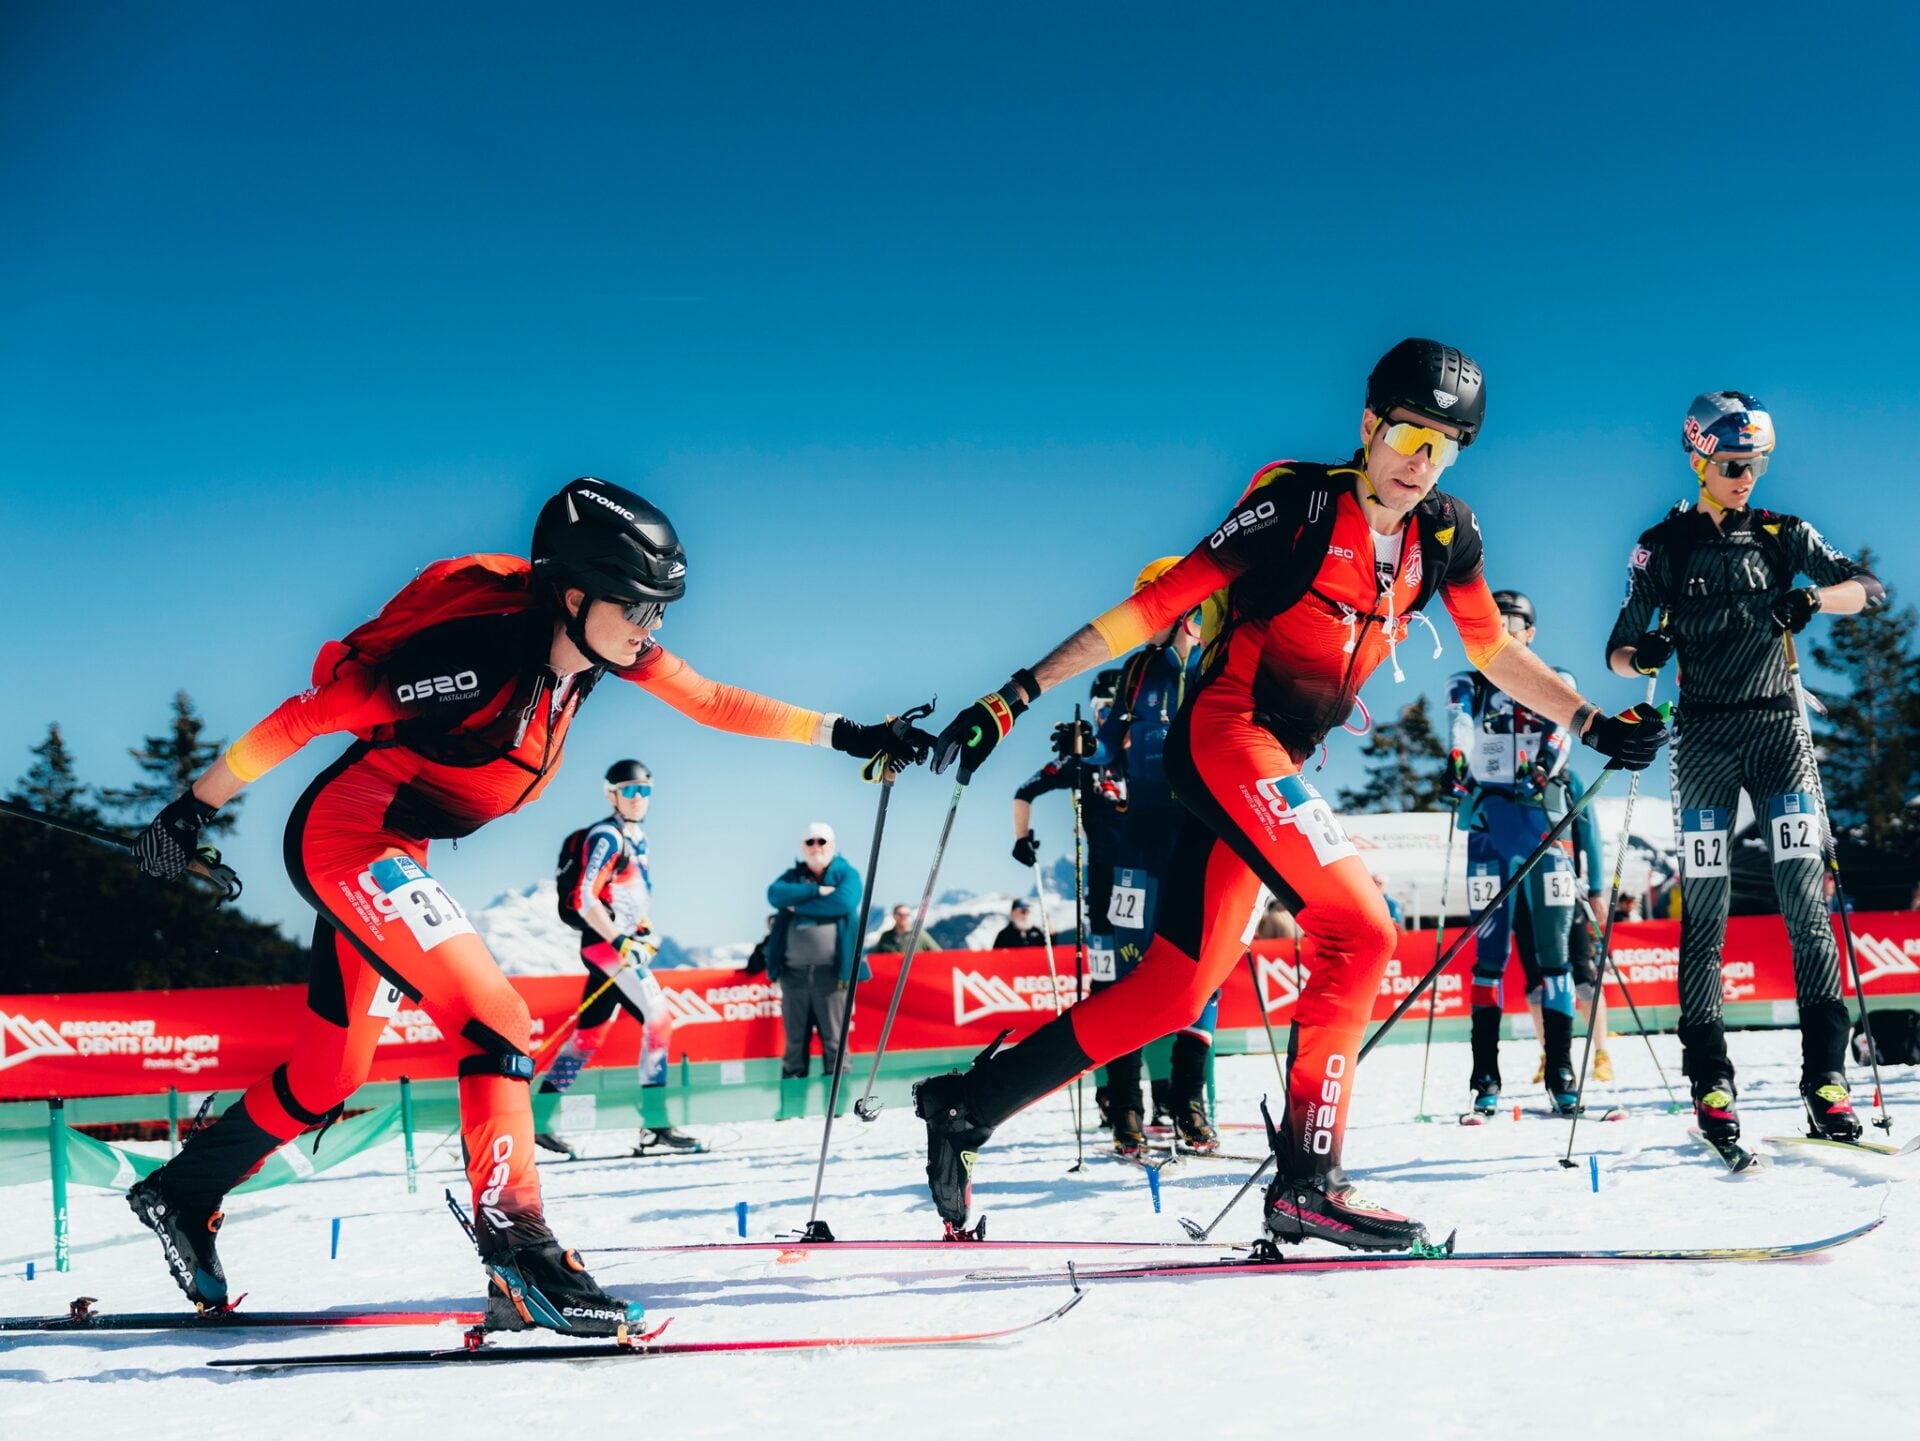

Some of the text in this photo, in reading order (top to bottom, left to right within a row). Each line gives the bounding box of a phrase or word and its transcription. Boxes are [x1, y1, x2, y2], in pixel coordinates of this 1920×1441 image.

[577, 488, 635, 521] ATOMIC
[1243, 516, 1279, 537] FAST&LIGHT
[439, 689, 480, 702] FAST&LIGHT
[1780, 820, 1810, 850] 6.2
[1694, 838, 1721, 868] 6.2
[1473, 881, 1494, 903] 5.2
[1552, 877, 1571, 898] 5.2
[410, 887, 462, 927] 3.1
[1115, 893, 1136, 918] 2.2
[1629, 964, 1679, 983] DENT
[723, 1000, 783, 1021] DENTS
[60, 1020, 138, 1037] REGION
[77, 1035, 219, 1054] DENTS DU MIDI
[1303, 1101, 1317, 1154] FAST&LIGHT
[1272, 1199, 1354, 1233] DYNAFIT
[57, 1207, 70, 1272] LISKI
[147, 1206, 194, 1287] SCARPA
[562, 1306, 626, 1322] SCARPA
